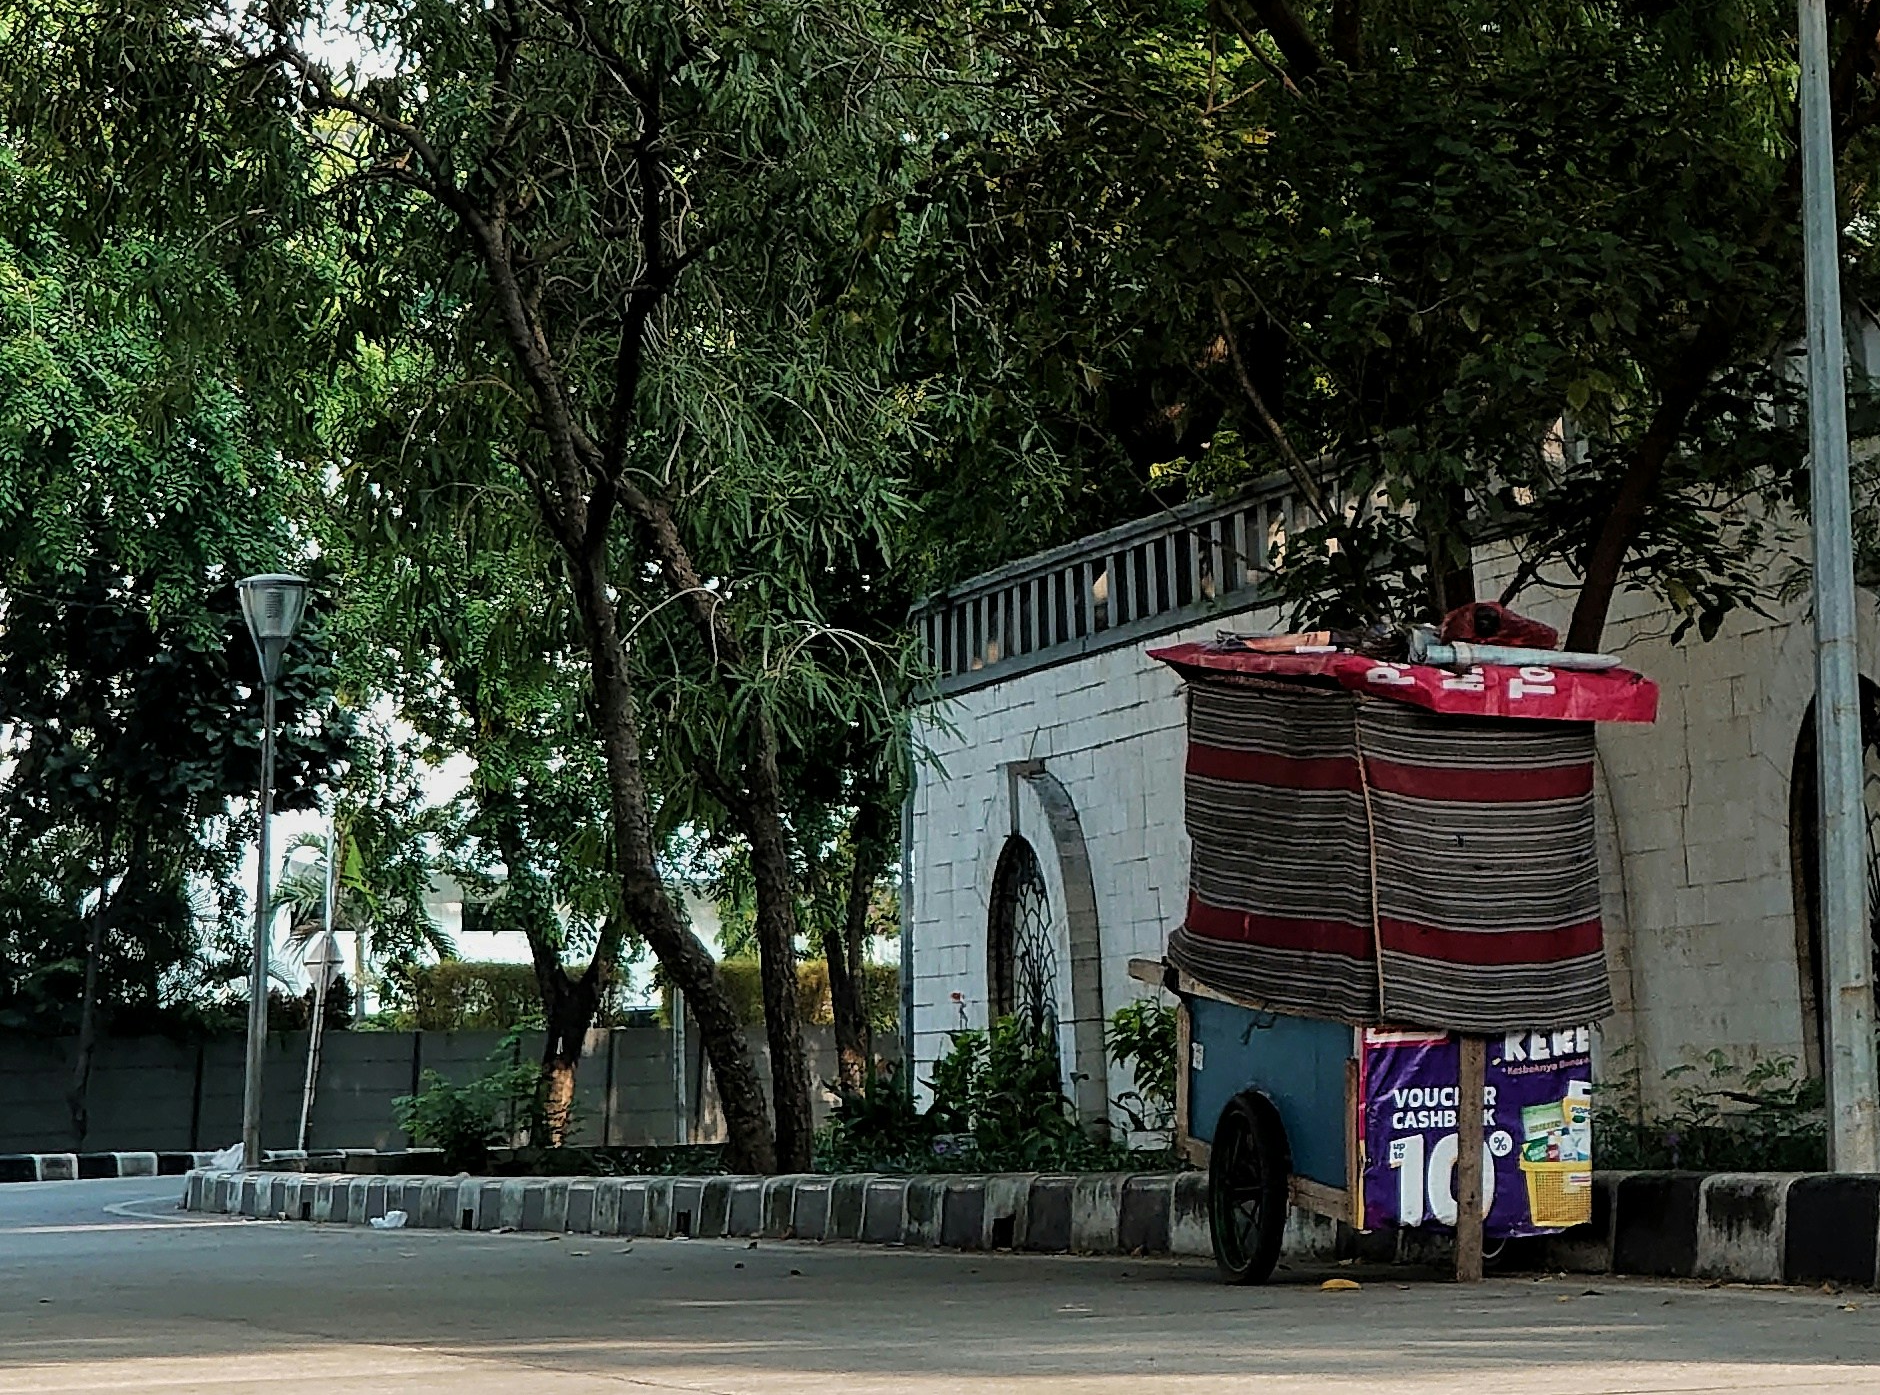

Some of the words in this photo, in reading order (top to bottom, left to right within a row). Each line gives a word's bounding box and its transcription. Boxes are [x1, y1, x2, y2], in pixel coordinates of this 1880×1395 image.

[1393, 1086, 1497, 1108] VOUCR
[1392, 1109, 1496, 1129] CASHBK
[1393, 1143, 1405, 1152] up
[1393, 1152, 1405, 1160] to
